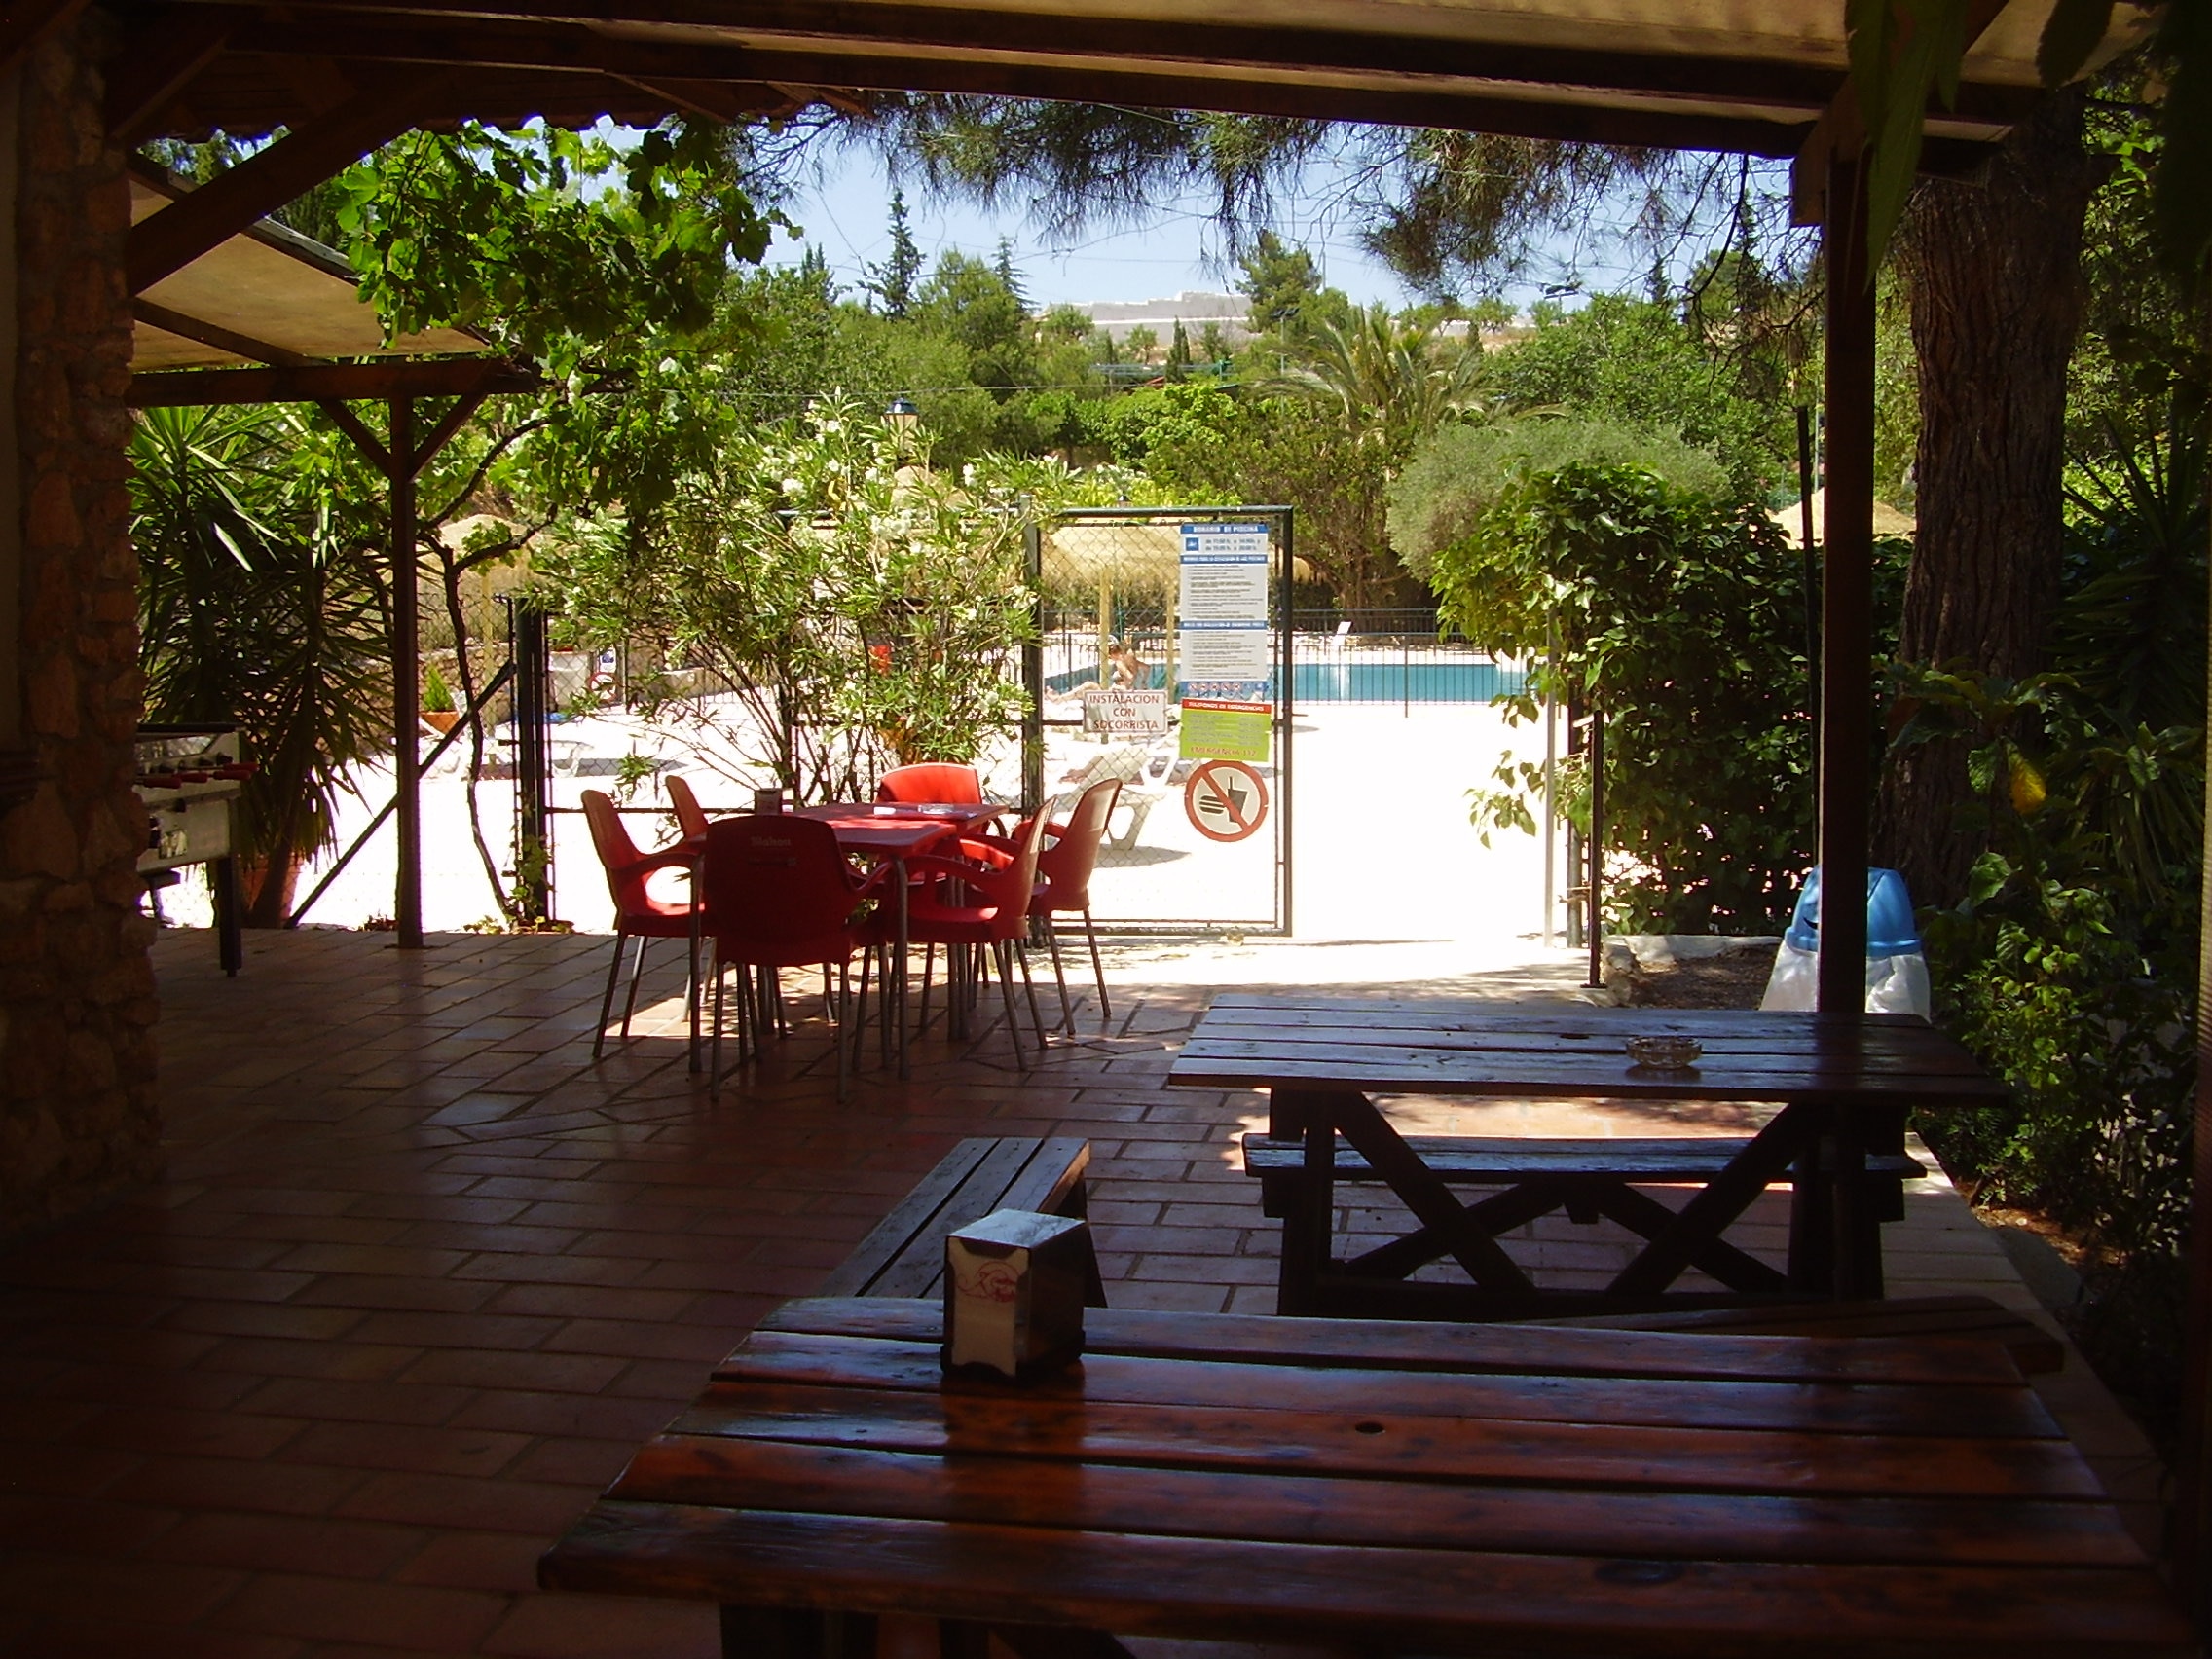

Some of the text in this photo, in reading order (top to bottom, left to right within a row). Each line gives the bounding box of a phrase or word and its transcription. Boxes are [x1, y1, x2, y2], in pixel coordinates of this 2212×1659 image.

[1088, 694, 1160, 704] INSTALACION
[1113, 707, 1136, 717] CON
[1093, 719, 1159, 729] SOCORRISTA
